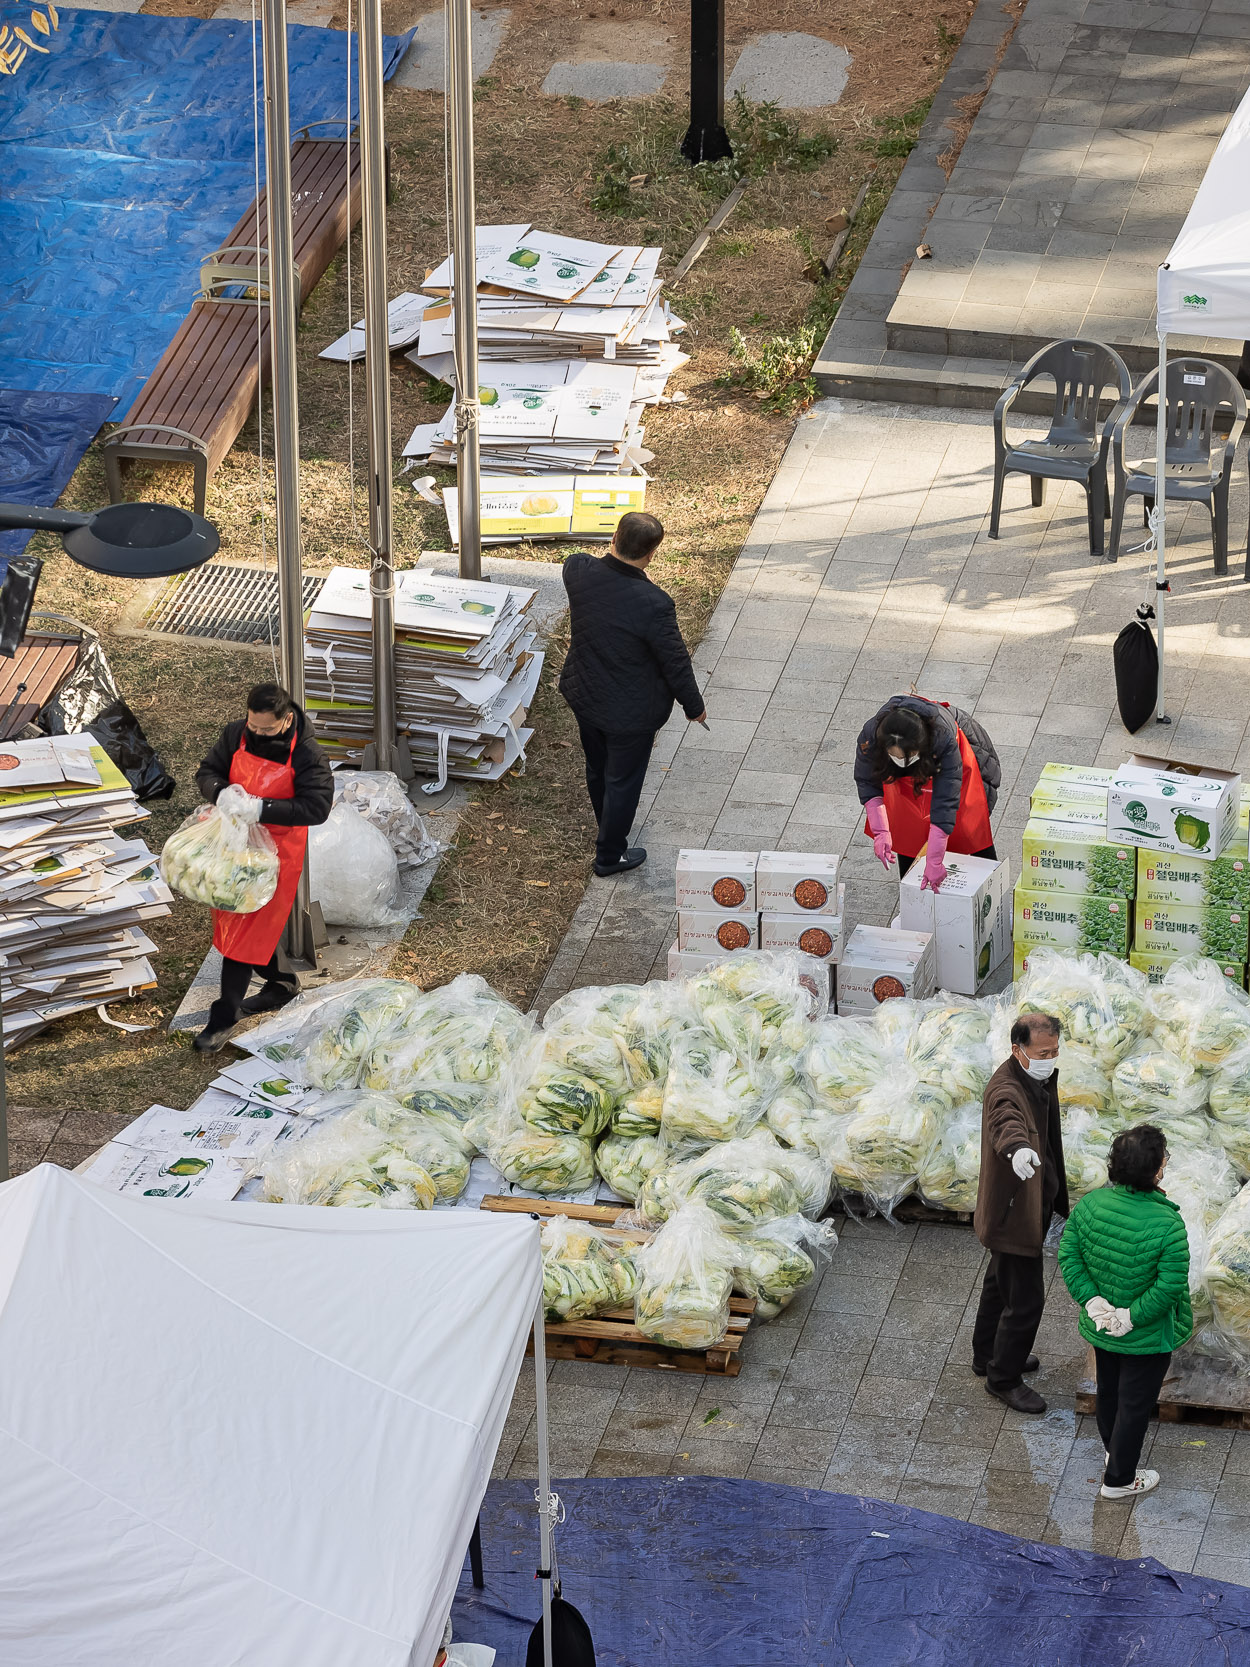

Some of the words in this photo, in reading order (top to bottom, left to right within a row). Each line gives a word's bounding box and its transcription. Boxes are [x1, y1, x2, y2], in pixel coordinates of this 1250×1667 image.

[1158, 842, 1175, 850] 20kg
[1040, 858, 1086, 870] 절임배추
[1156, 870, 1201, 882] 절임배추
[1032, 910, 1078, 924] 절임배추
[1154, 912, 1168, 920] 괴산
[1154, 920, 1200, 934] 절임배추
